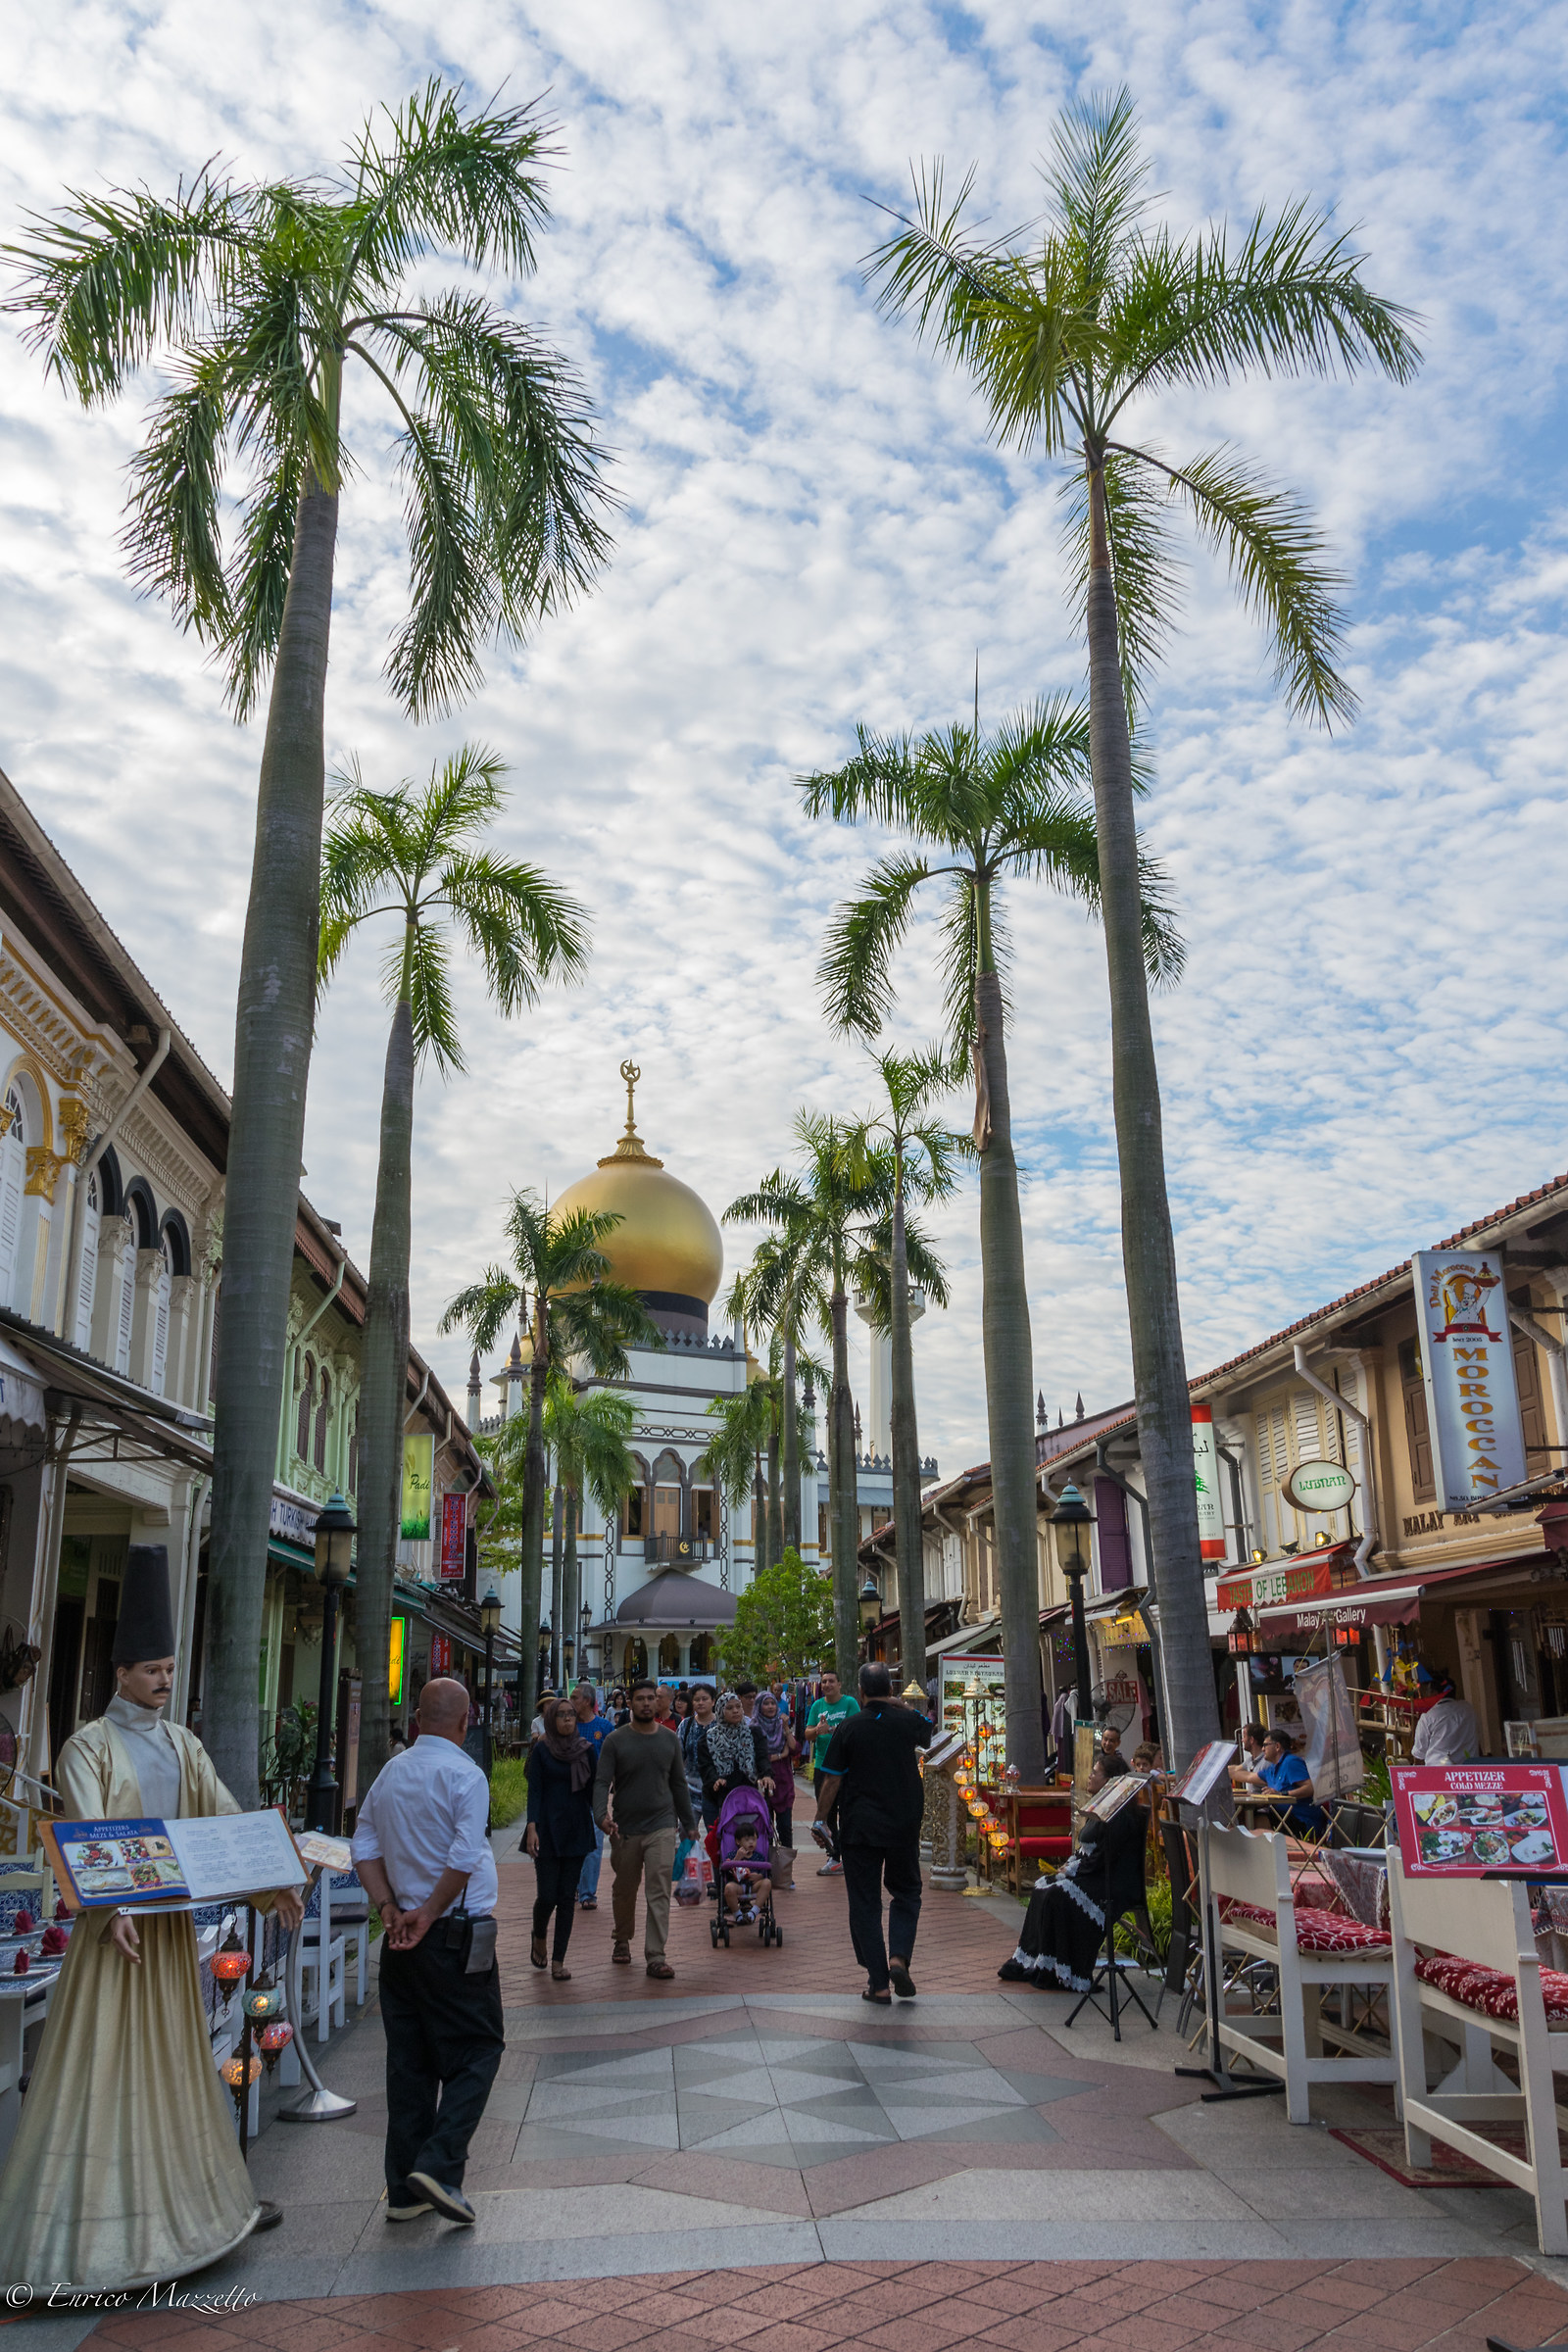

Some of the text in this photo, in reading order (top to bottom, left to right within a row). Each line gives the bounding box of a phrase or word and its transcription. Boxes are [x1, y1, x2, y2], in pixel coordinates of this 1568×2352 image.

[1430, 1264, 1476, 1285] Moroccan
[1452, 1347, 1502, 1490] MOROCCAN
[409, 1474, 430, 1490] Padi
[1298, 1475, 1347, 1492] LUBNAN
[280, 1502, 306, 1531] TURKISH
[1402, 1510, 1445, 1537] MALAY
[1228, 1570, 1315, 1605] TASTE OF LEBANON
[1297, 1611, 1320, 1629] Malay
[1336, 1606, 1366, 1624] Gallery
[1107, 1682, 1137, 1703] SALE
[1445, 1771, 1505, 1782] APPETIZER
[1450, 1782, 1503, 1790] COLD MEZZE
[94, 1824, 130, 1833] APPETIZERS
